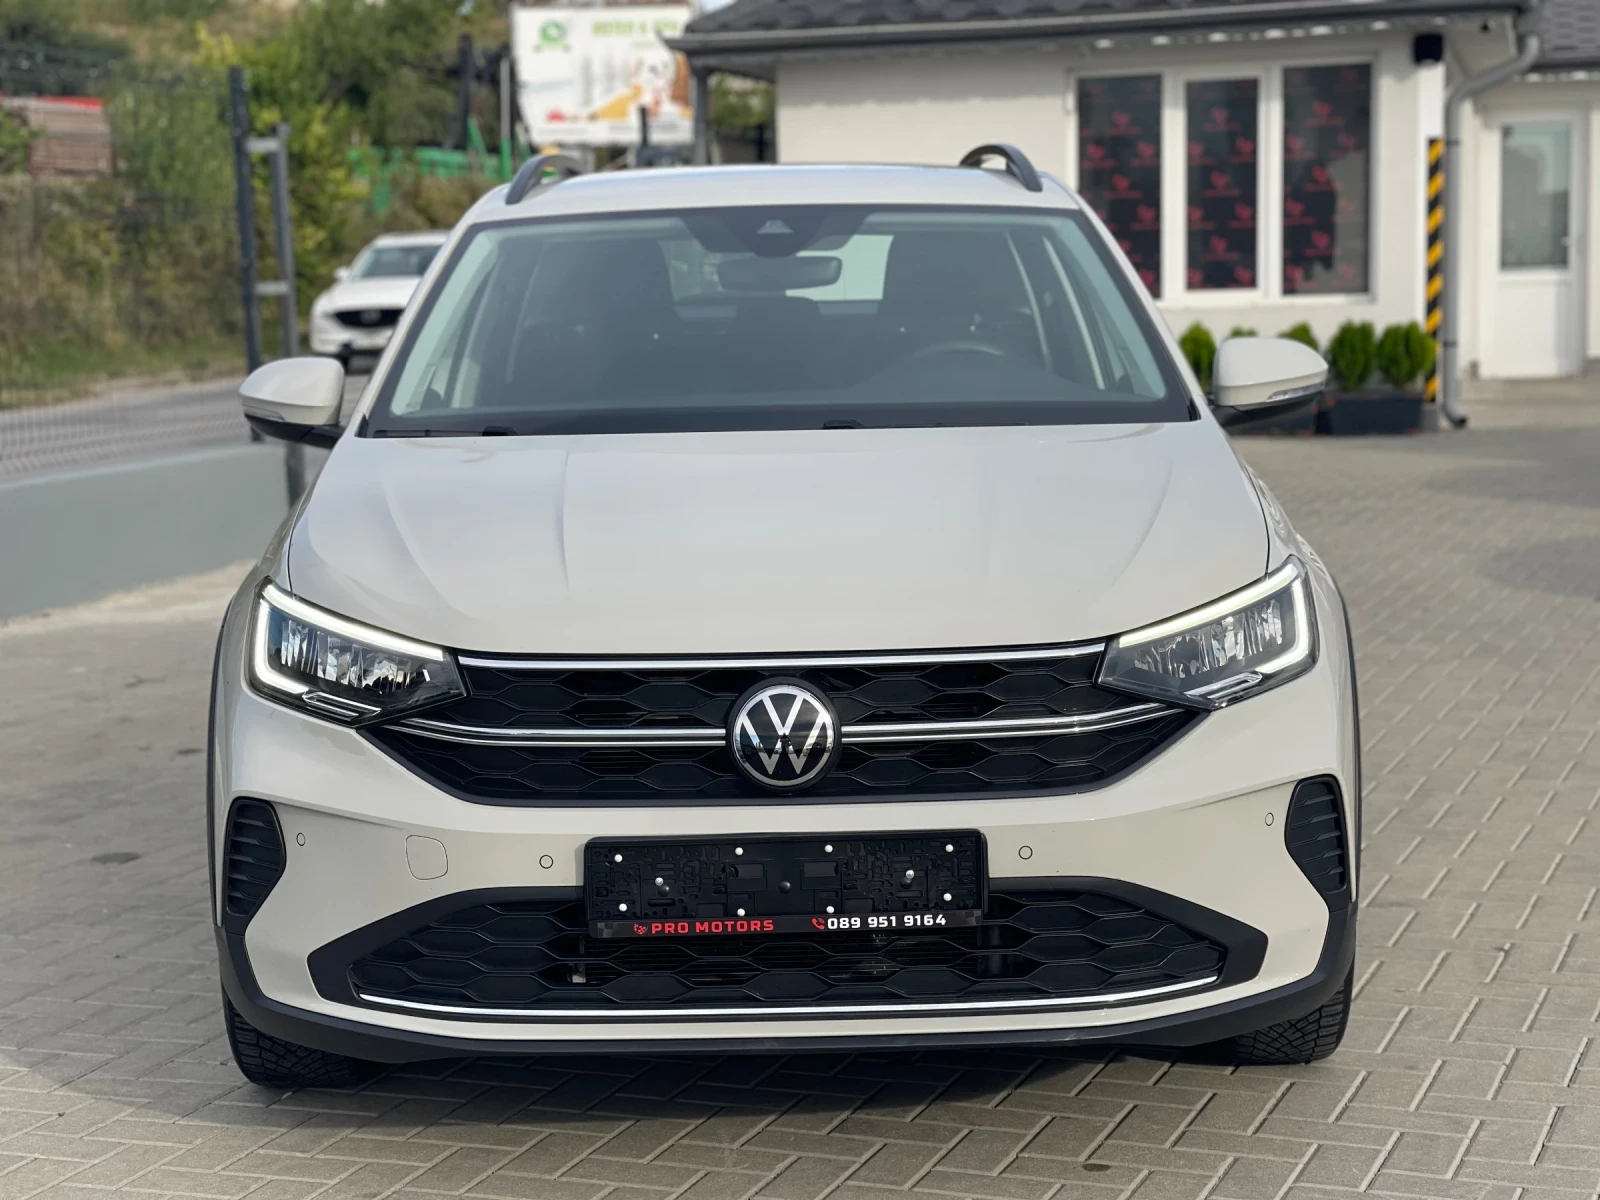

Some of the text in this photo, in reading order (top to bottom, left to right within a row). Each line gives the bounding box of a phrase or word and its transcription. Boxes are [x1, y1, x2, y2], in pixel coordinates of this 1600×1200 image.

[651, 919, 774, 934] PRO MOTORS
[827, 914, 947, 930] 089 951 9164
